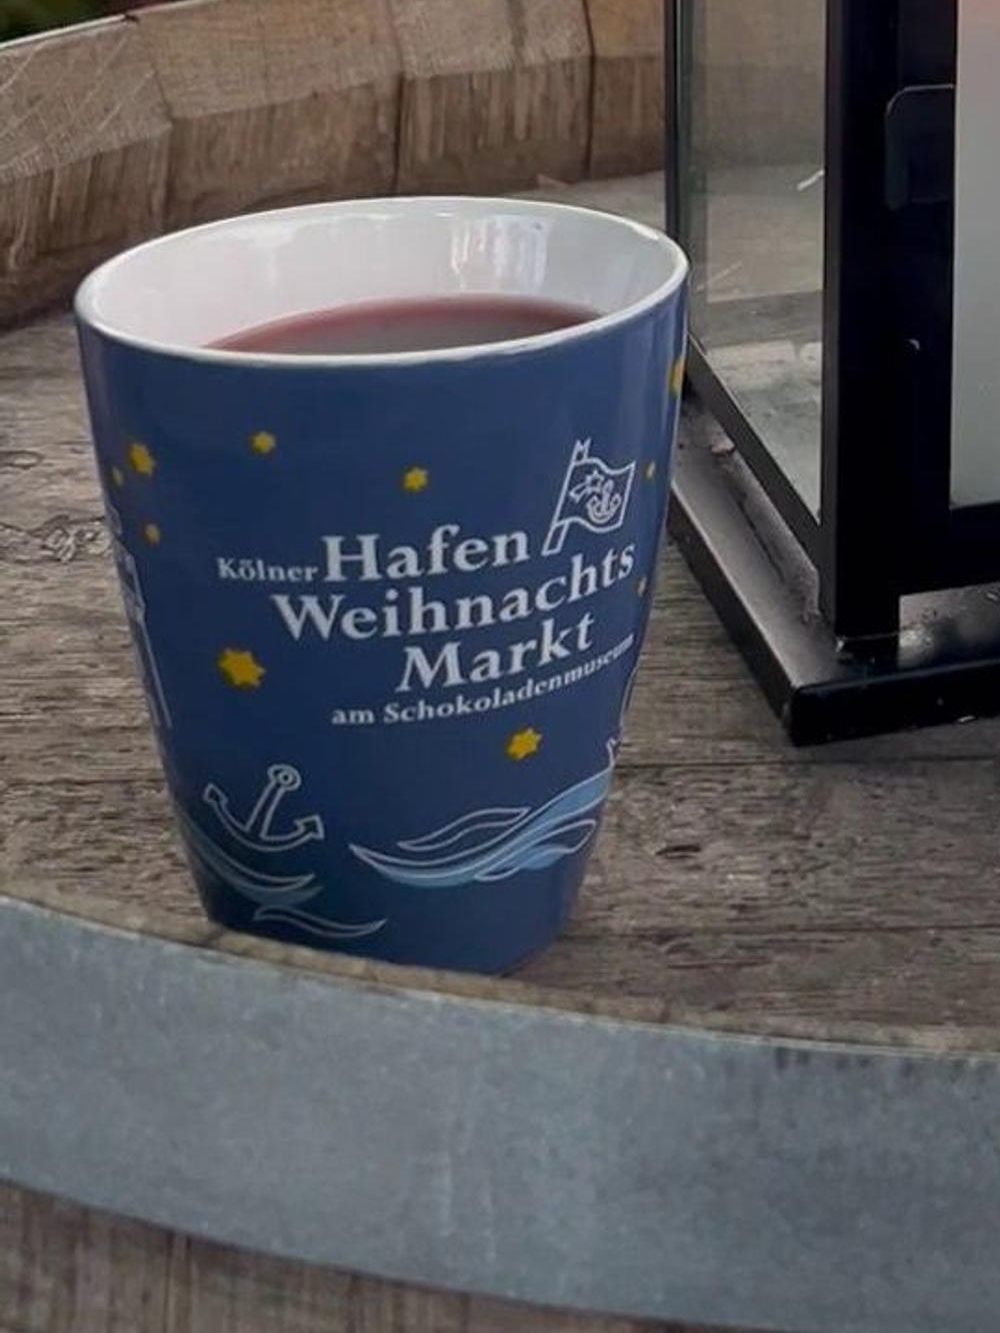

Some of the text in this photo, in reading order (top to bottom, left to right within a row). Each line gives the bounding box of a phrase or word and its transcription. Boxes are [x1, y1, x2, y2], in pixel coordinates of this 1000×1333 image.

[217, 524, 530, 583] Kölner Hafen
[271, 544, 636, 642] Weihnachts
[331, 633, 635, 725] am Schokoladenmuseum
[394, 611, 595, 692] Markt
